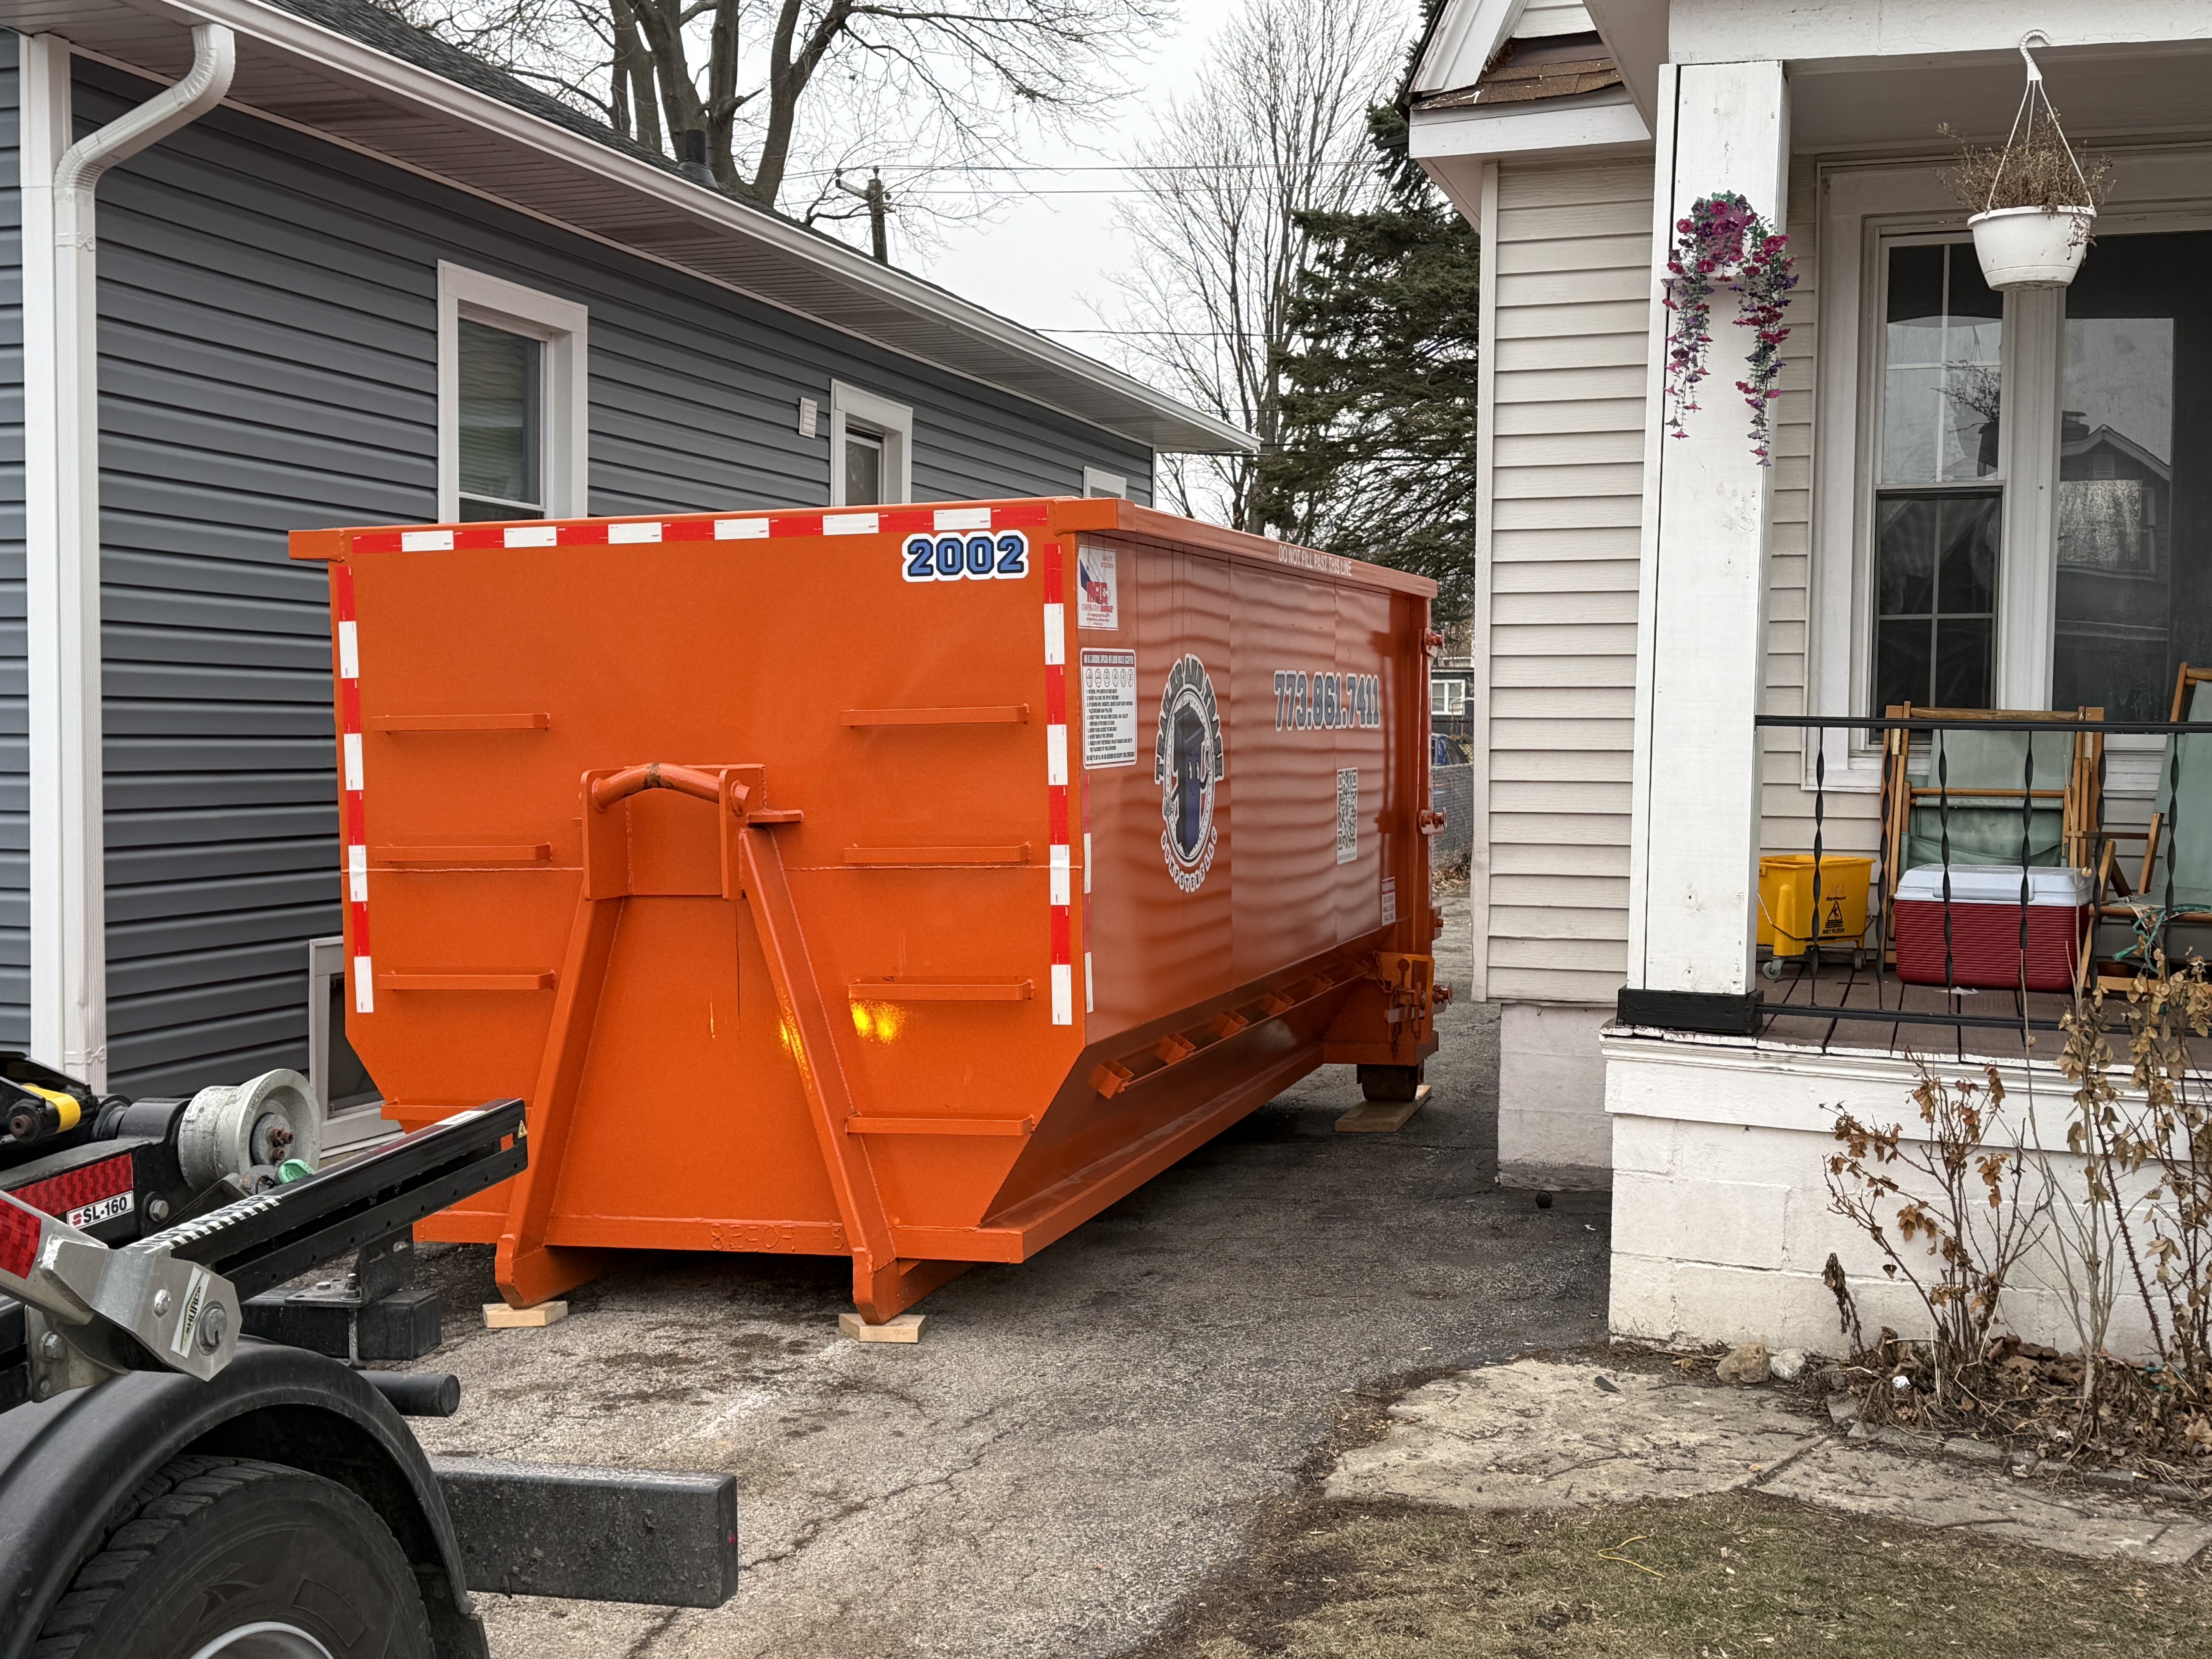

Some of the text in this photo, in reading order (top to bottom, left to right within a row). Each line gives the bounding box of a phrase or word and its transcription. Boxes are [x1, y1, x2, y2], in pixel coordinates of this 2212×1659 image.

[907, 535, 1024, 577] 2002
[1279, 544, 1352, 577] DO NOT FILL PAST THIS LINE
[1185, 657, 1203, 692] AND
[1204, 677, 1222, 777] TRASH
[1274, 672, 1379, 729] 773.861.7411
[1161, 828, 1216, 891] DUMPSTERS LLC
[83, 1196, 127, 1223] SL-160
[136, 1227, 194, 1246] NOT
[208, 1196, 269, 1217] STEP
